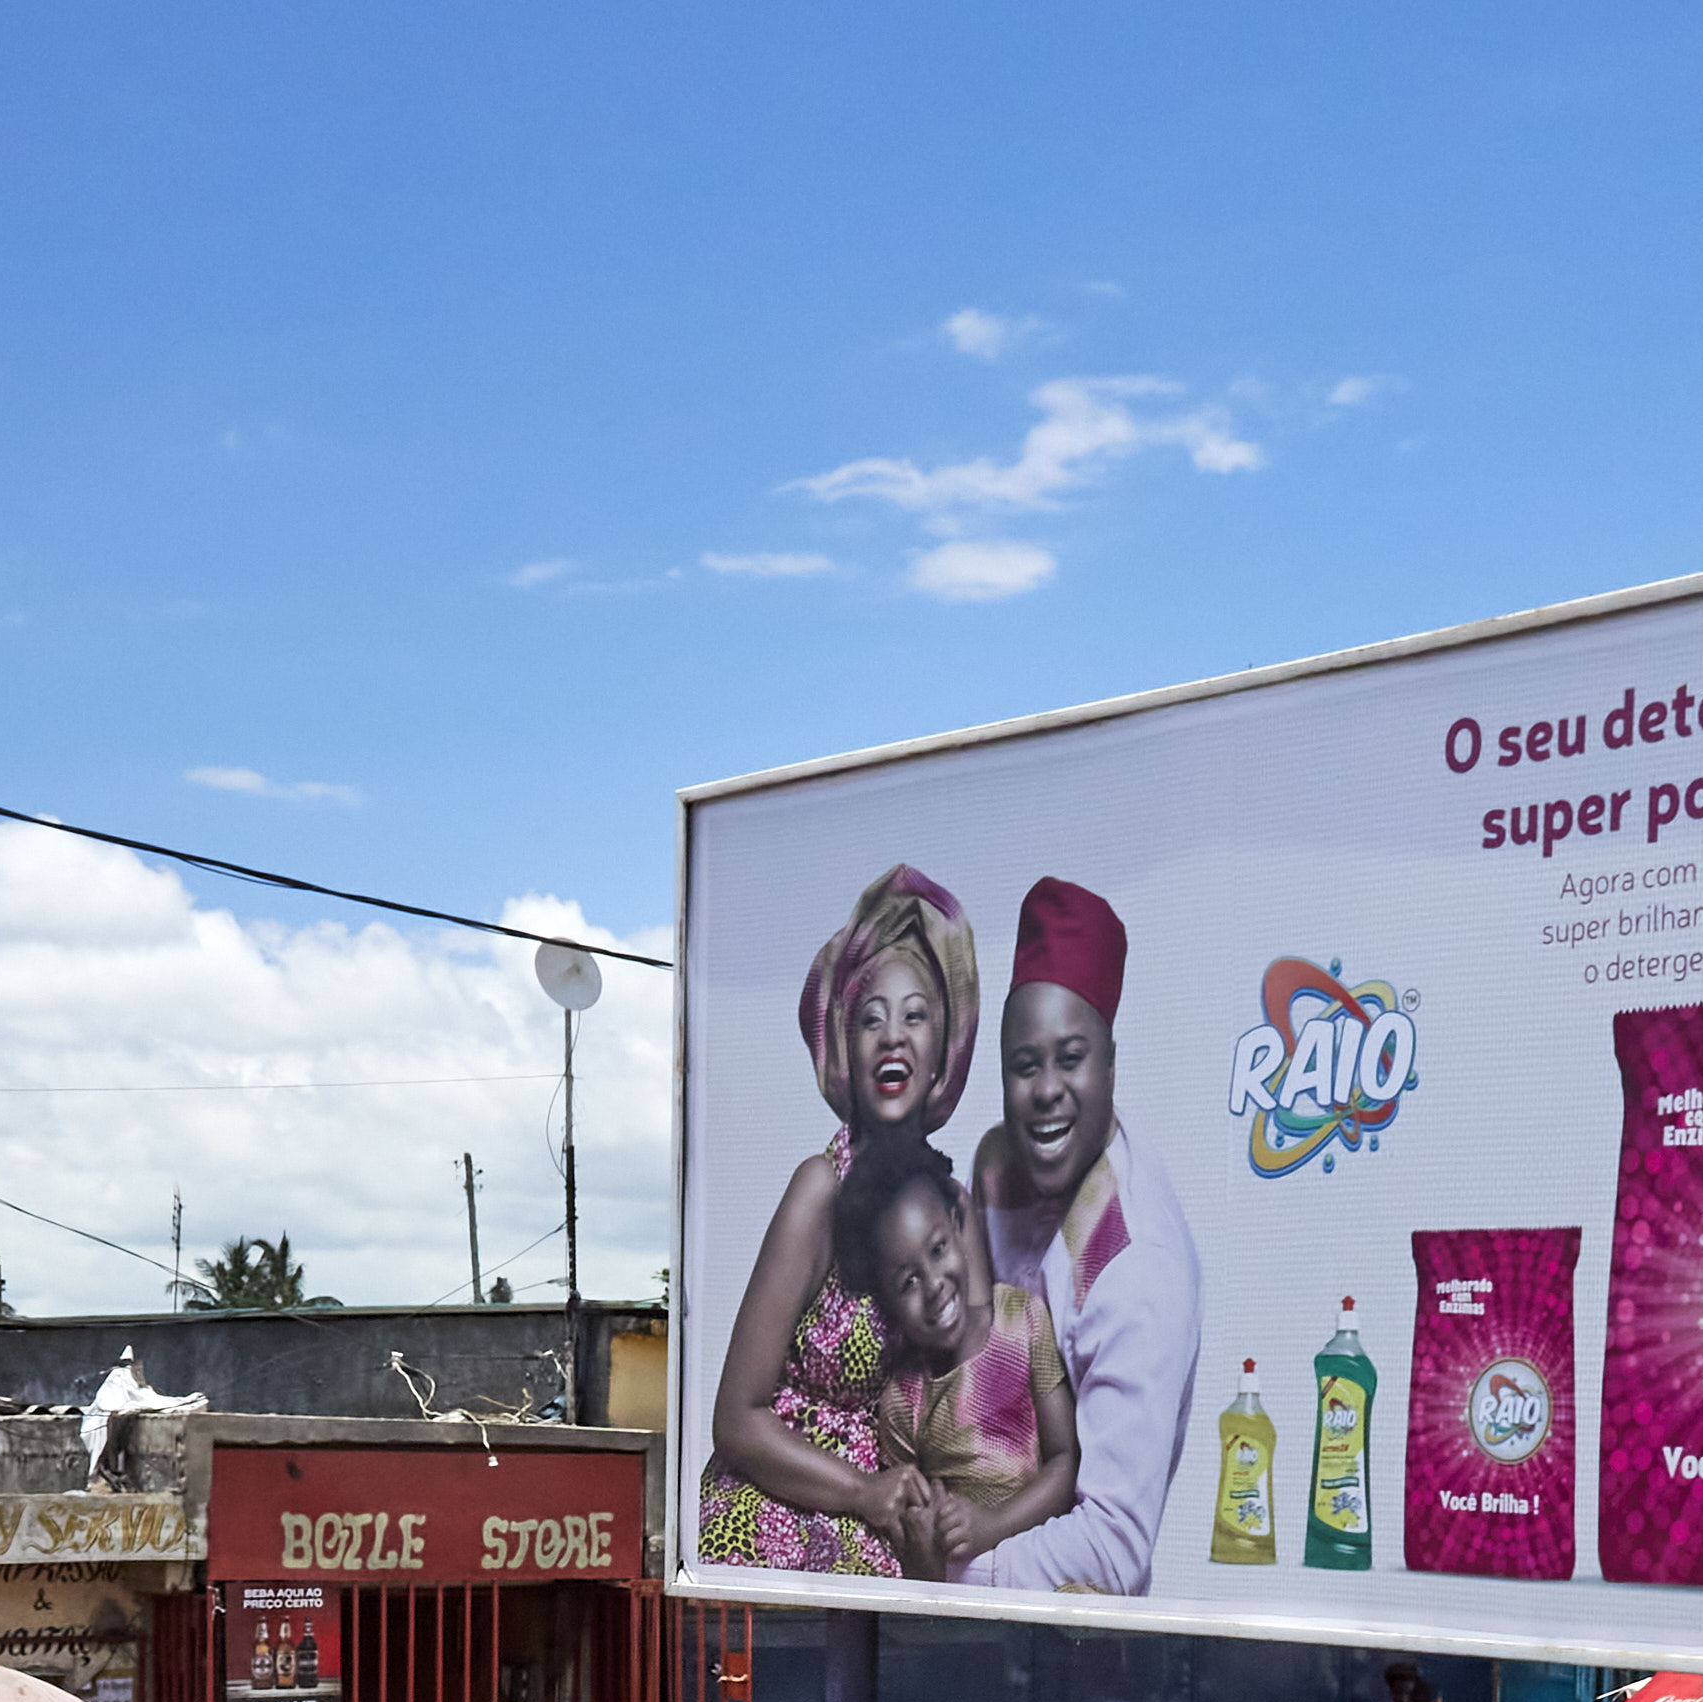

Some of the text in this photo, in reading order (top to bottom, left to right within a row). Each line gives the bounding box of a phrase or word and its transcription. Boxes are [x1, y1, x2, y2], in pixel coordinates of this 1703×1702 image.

[1445, 717, 1482, 774] O
[1498, 714, 1587, 767] seu
[1482, 788, 1631, 858] super
[1559, 872, 1635, 906] Agora
[1642, 860, 1698, 890] com
[1542, 916, 1610, 947] super
[1584, 963, 1599, 984] o
[1229, 1010, 1416, 1116] RAIO
[1436, 1278, 1493, 1294] Melhorado
[1323, 1410, 1357, 1427] RAIO
[1478, 1396, 1540, 1425] RAIO
[1440, 1490, 1476, 1511] Você
[1481, 1492, 1529, 1514] Brilha
[481, 1512, 614, 1570] STORE
[243, 1598, 323, 1609] PREÇO CERTO
[244, 1588, 322, 1599] BEBA AQUI AO
